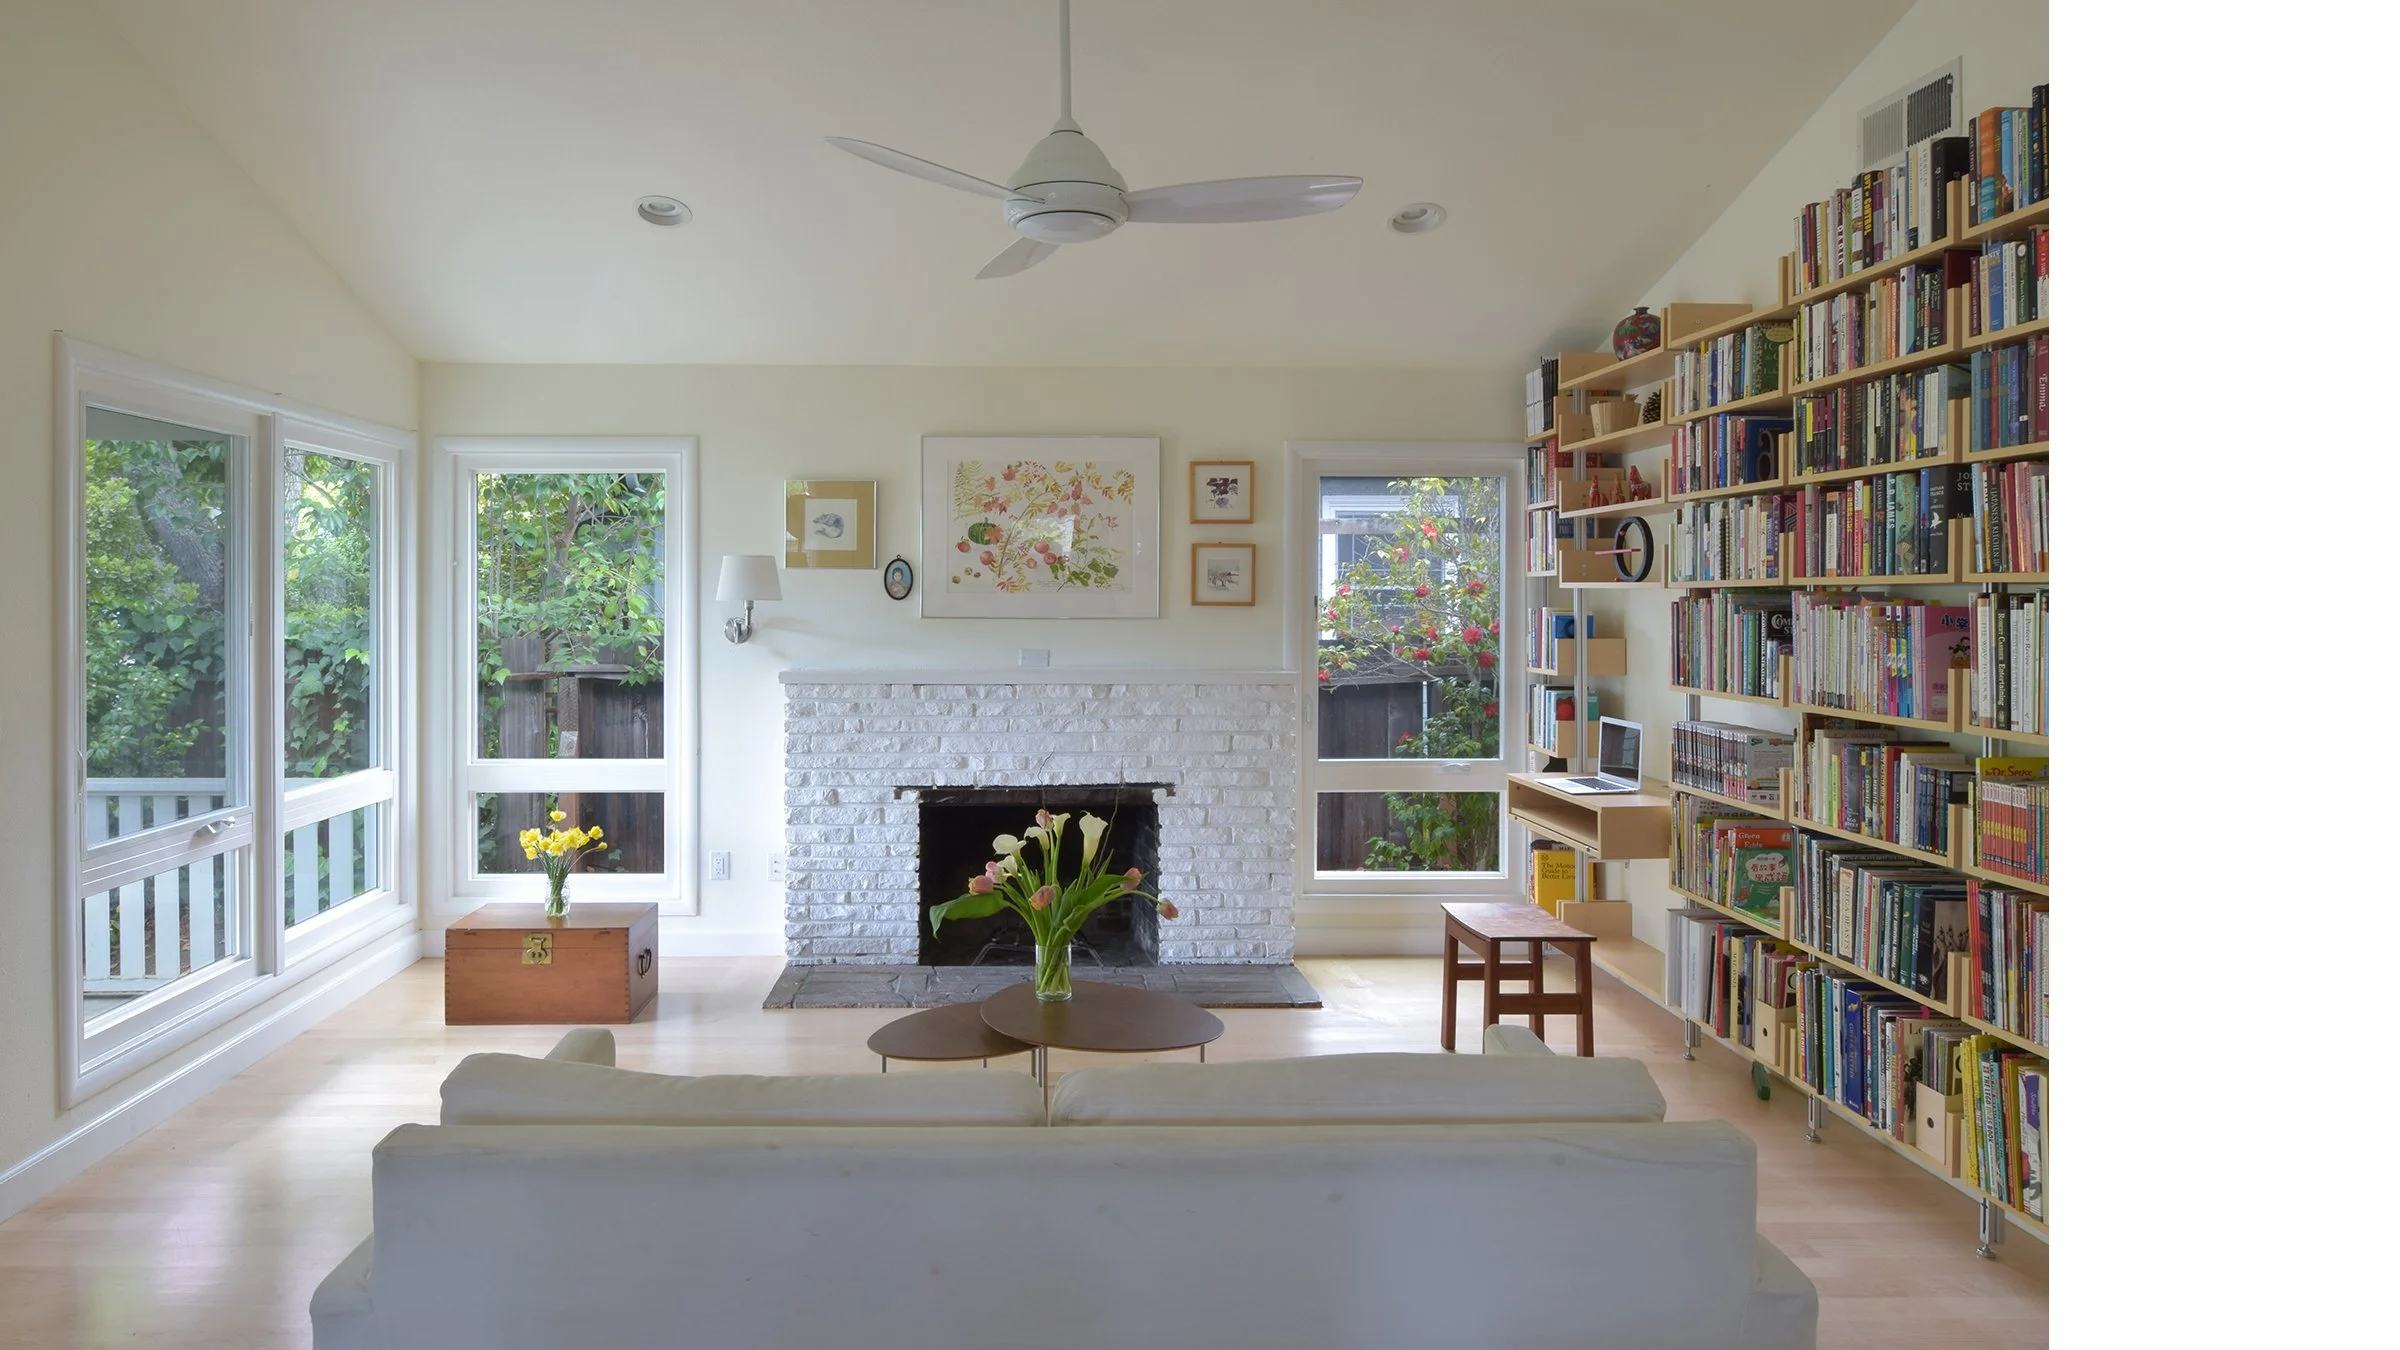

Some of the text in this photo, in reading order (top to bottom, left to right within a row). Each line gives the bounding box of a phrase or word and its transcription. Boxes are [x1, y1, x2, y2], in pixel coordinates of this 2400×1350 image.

[1863, 174, 1873, 190] OUT
[1863, 198, 1873, 236] CONTROL
[2038, 373, 2047, 412] Emma
[1887, 502, 1895, 529] JAMES
[1990, 491, 1999, 558] JAPANESE KITCHEN
[1997, 664, 2006, 706] Entertaining
[1738, 832, 1761, 840] Green
